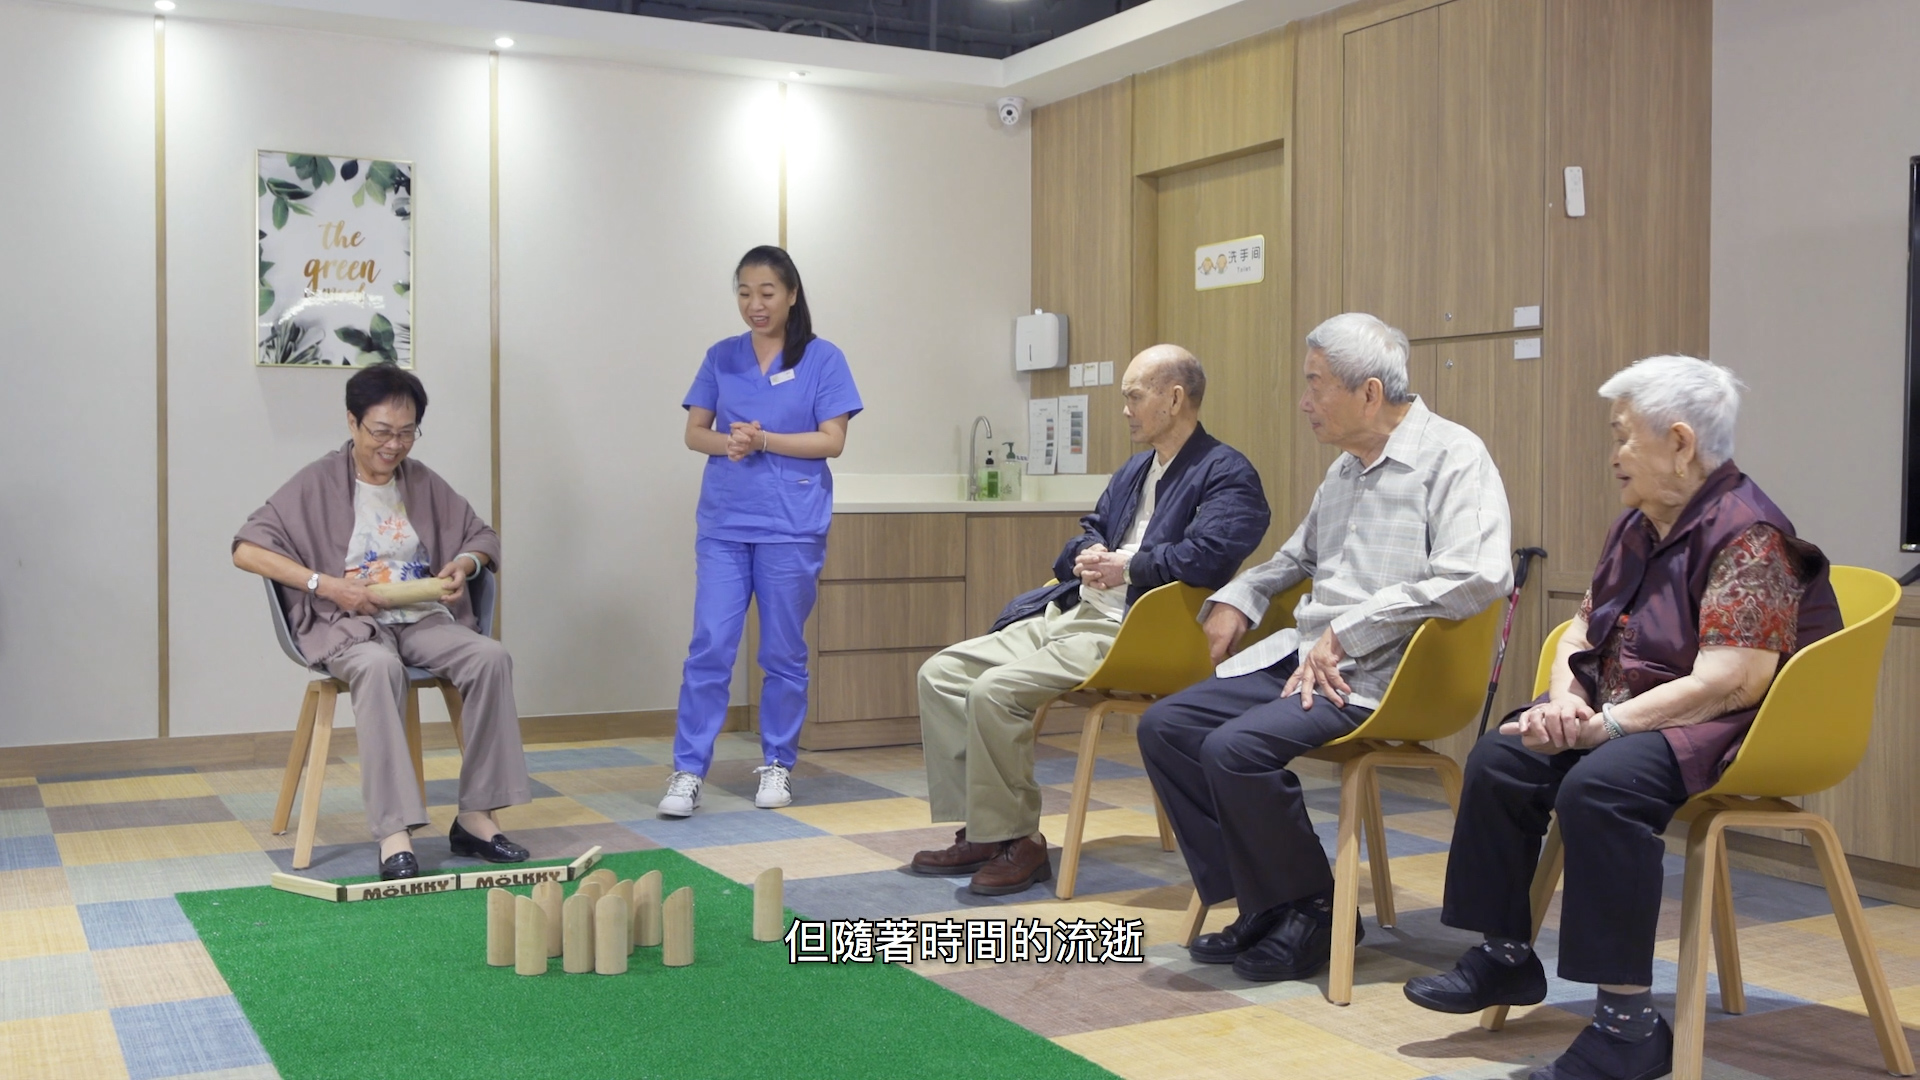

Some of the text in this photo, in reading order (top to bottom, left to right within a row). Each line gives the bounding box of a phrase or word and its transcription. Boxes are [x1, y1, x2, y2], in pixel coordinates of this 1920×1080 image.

[318, 220, 366, 250] the
[1228, 246, 1261, 264] 洗手间
[303, 258, 382, 297] green
[362, 879, 449, 901] MÖLKKY
[476, 870, 560, 889] MÖLKKY
